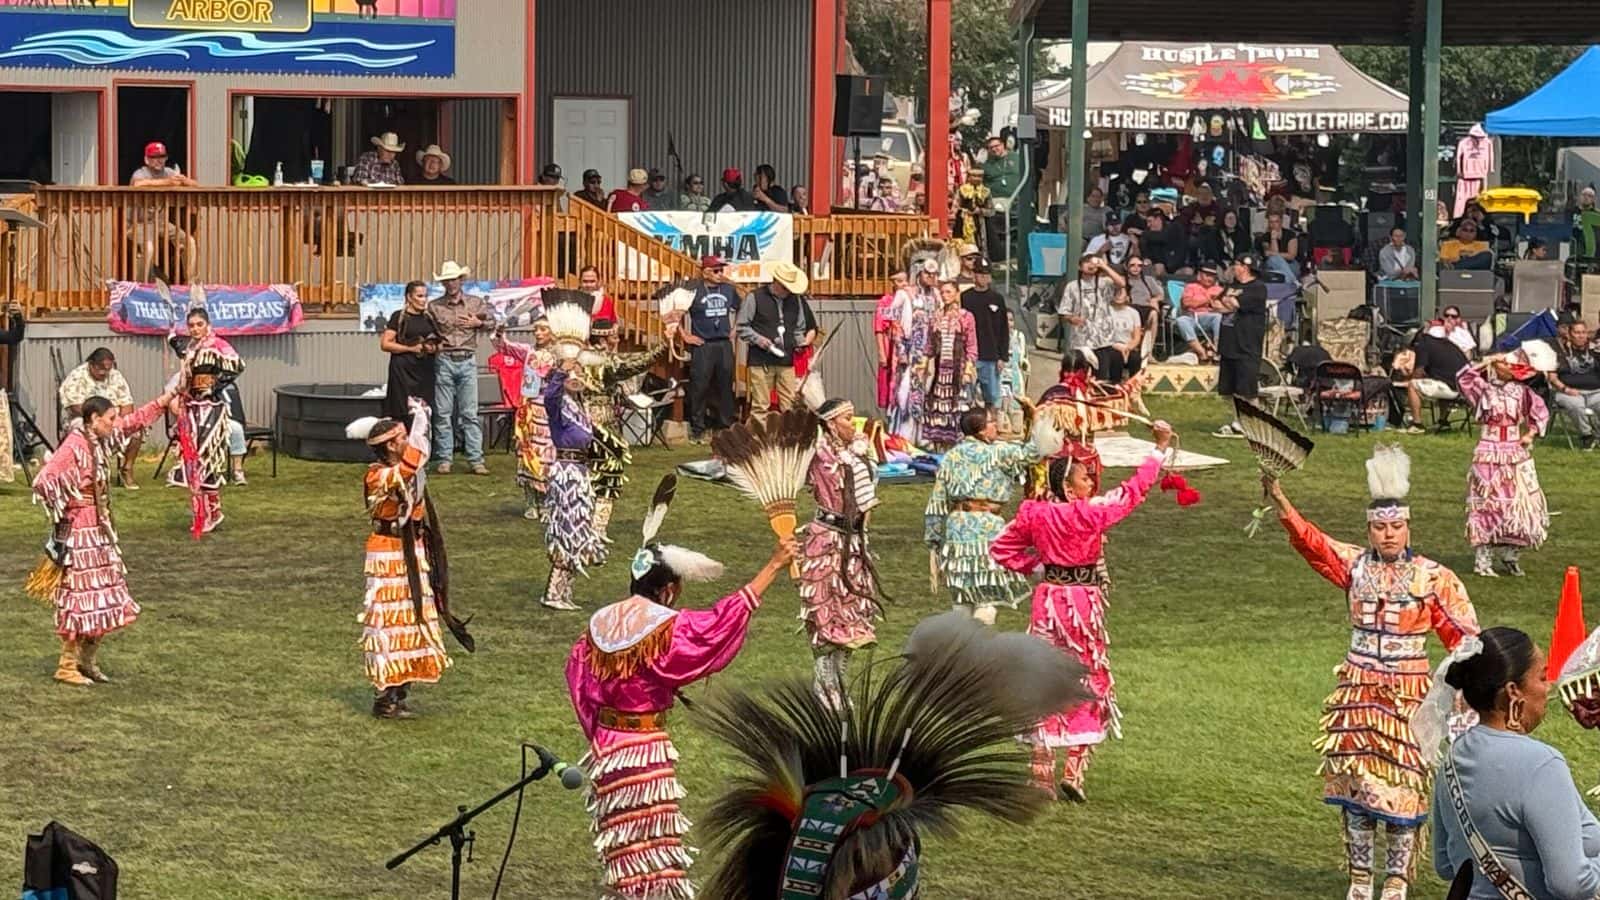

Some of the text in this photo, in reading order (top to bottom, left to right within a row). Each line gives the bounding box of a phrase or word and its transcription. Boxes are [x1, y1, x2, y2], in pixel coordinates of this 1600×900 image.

[166, 0, 273, 23] ARBOR
[1141, 43, 1320, 65] HUSTLE TRIBE
[1049, 107, 1190, 130] HUTLETRIBE.CO
[211, 300, 284, 321] VETERANS
